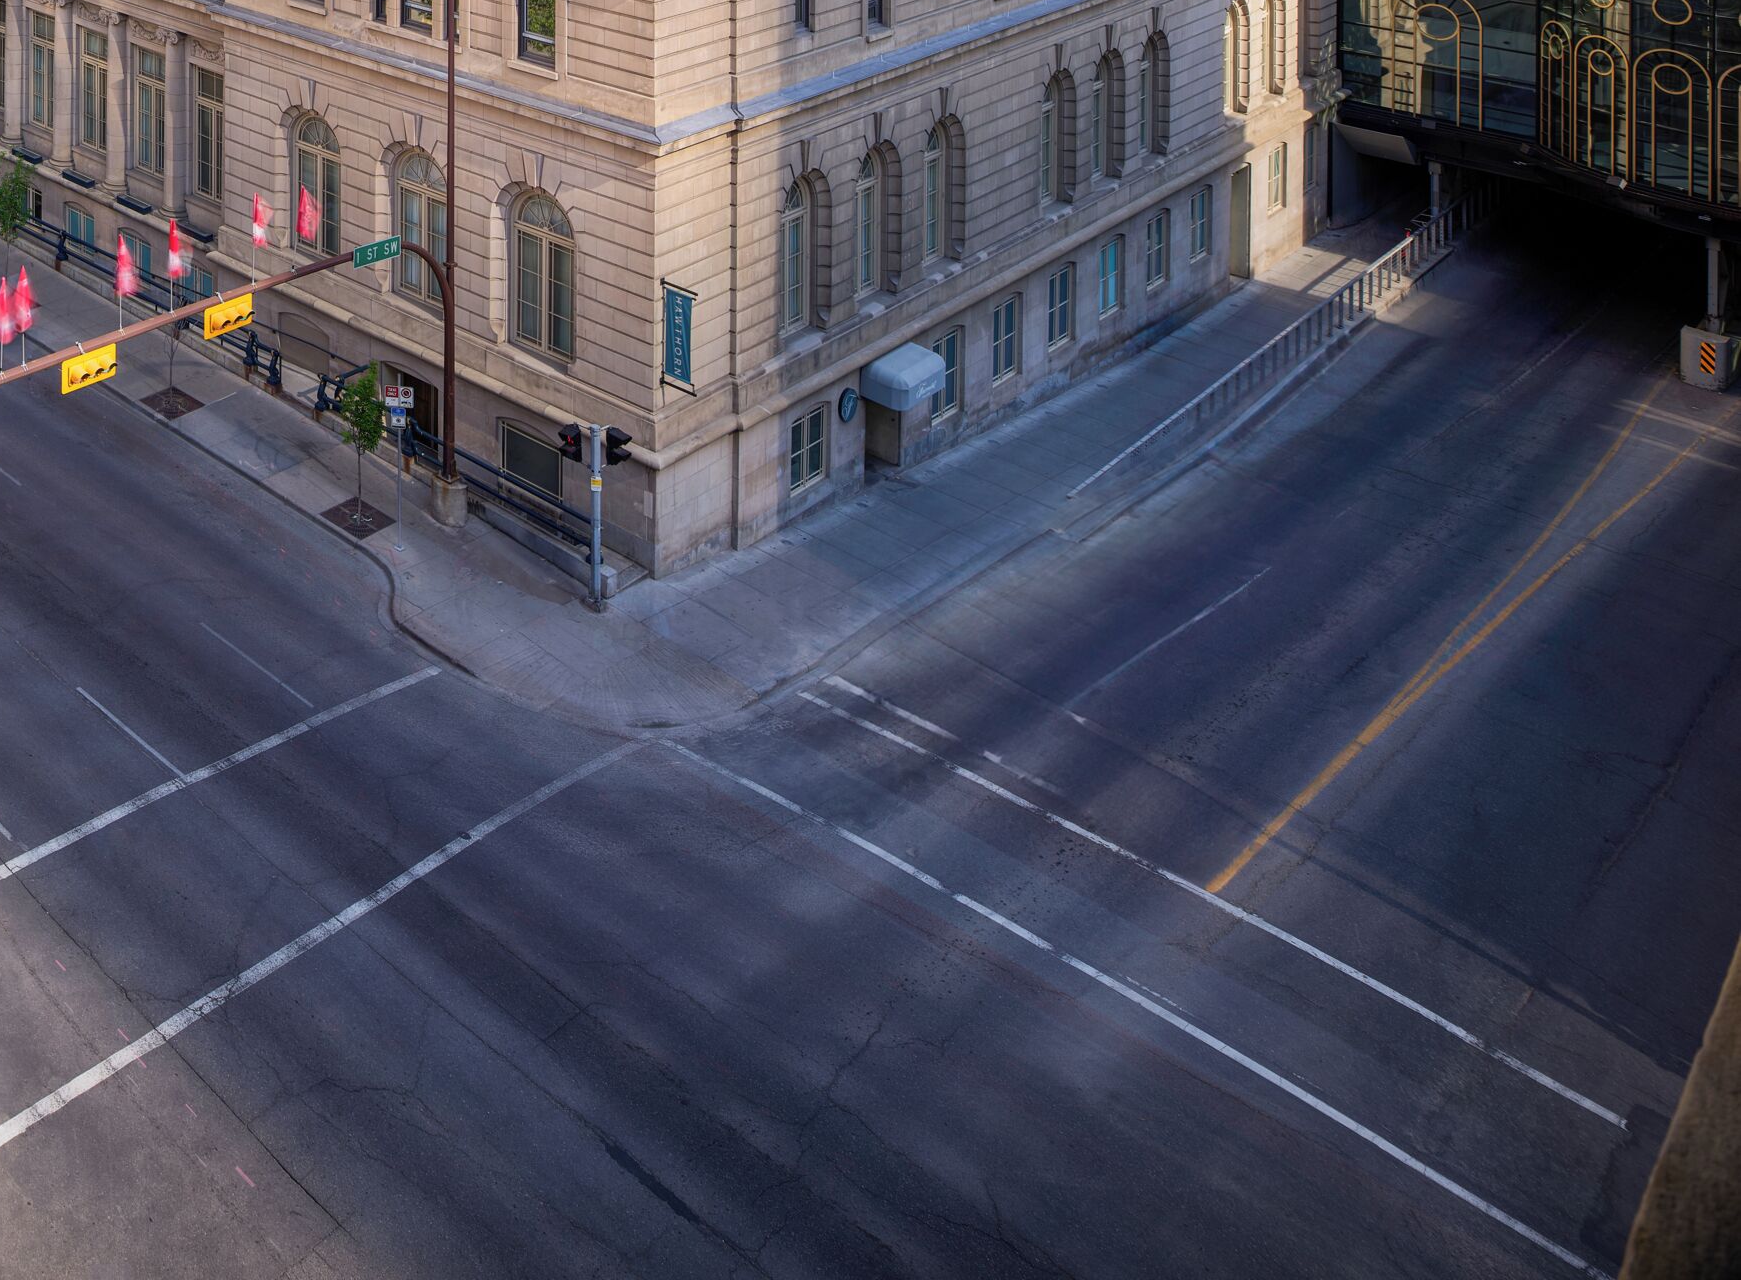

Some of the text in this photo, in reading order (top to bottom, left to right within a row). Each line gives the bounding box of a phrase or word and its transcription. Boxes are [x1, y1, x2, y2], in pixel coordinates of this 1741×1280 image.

[355, 240, 398, 264] 1 ST SW
[673, 295, 683, 377] HAWTHORN
